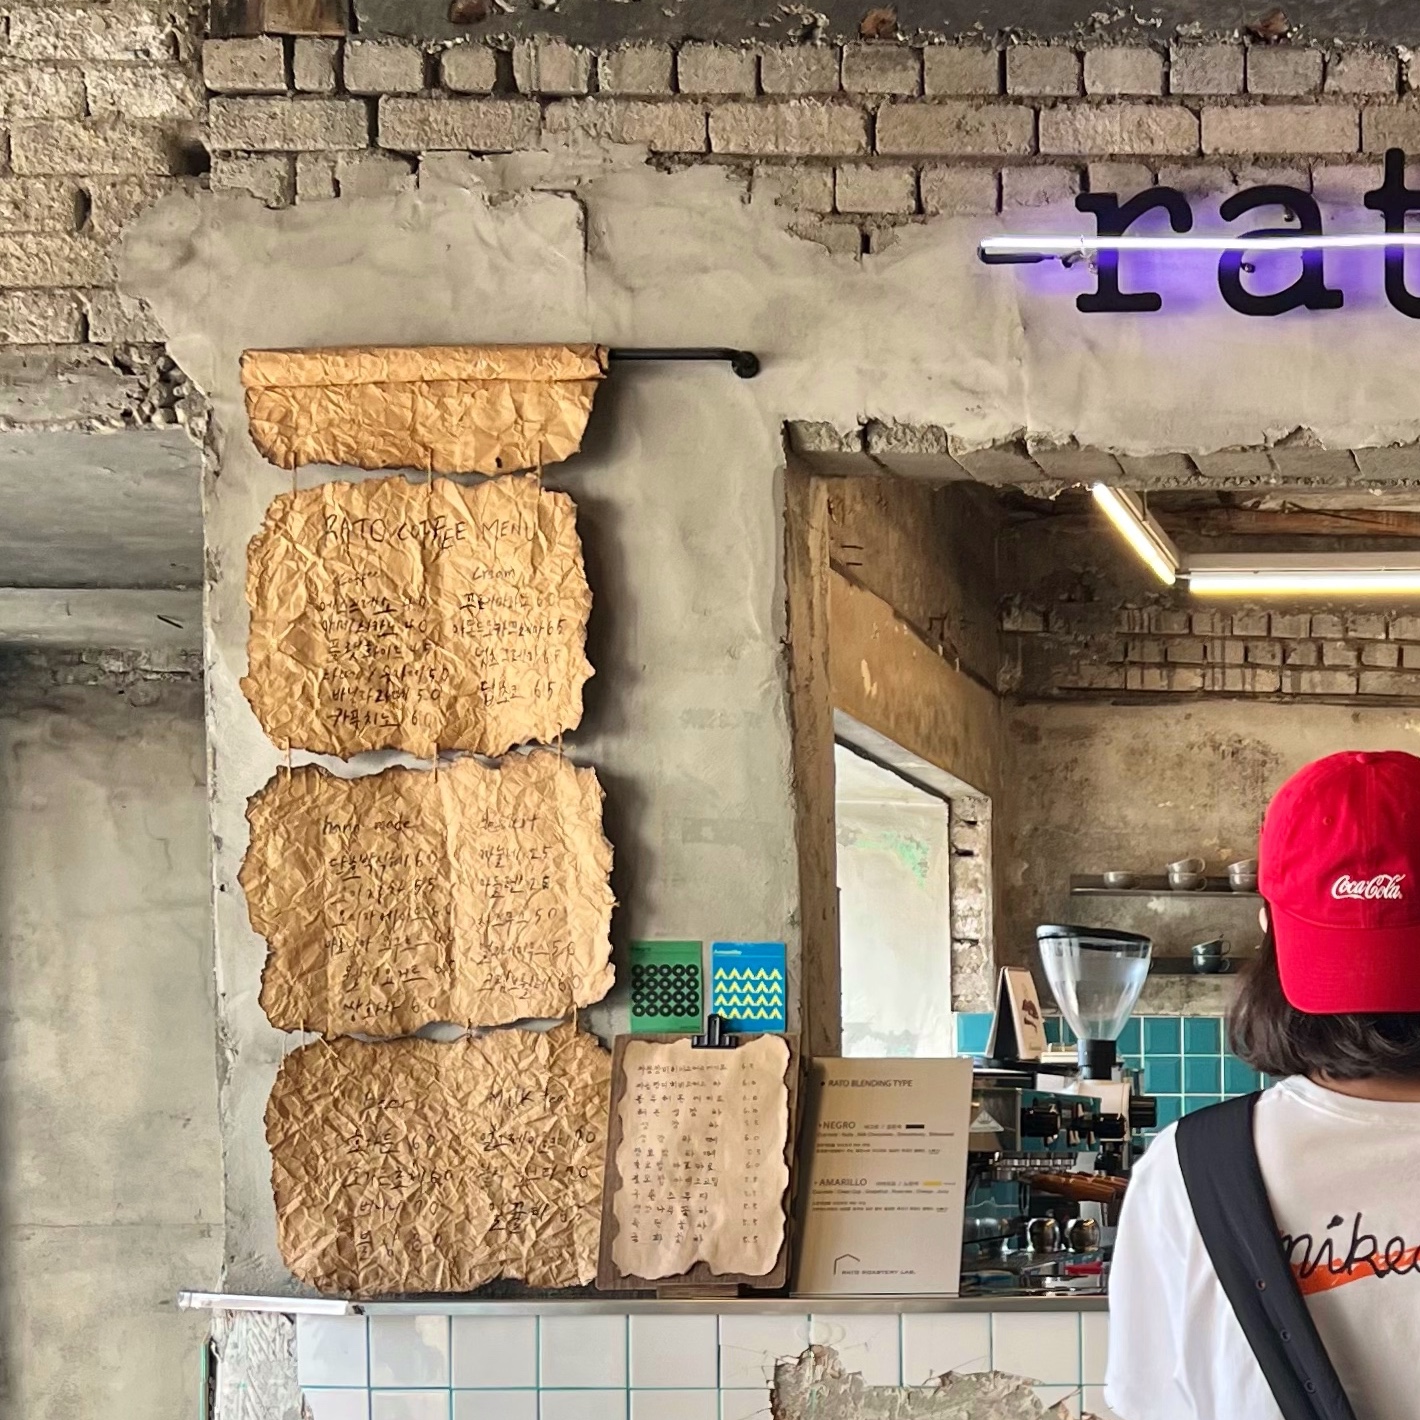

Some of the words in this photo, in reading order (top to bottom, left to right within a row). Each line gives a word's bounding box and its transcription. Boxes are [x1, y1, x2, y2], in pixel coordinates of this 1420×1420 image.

[323, 512, 387, 543] RATO
[397, 515, 466, 550] COFFEE
[482, 519, 536, 541] MENU
[828, 1079, 850, 1087] RATO
[851, 1079, 892, 1087] BLENDING
[893, 1079, 914, 1087] TYPE
[822, 1121, 856, 1129] NEGRO
[819, 1178, 868, 1187] AMARILLO
